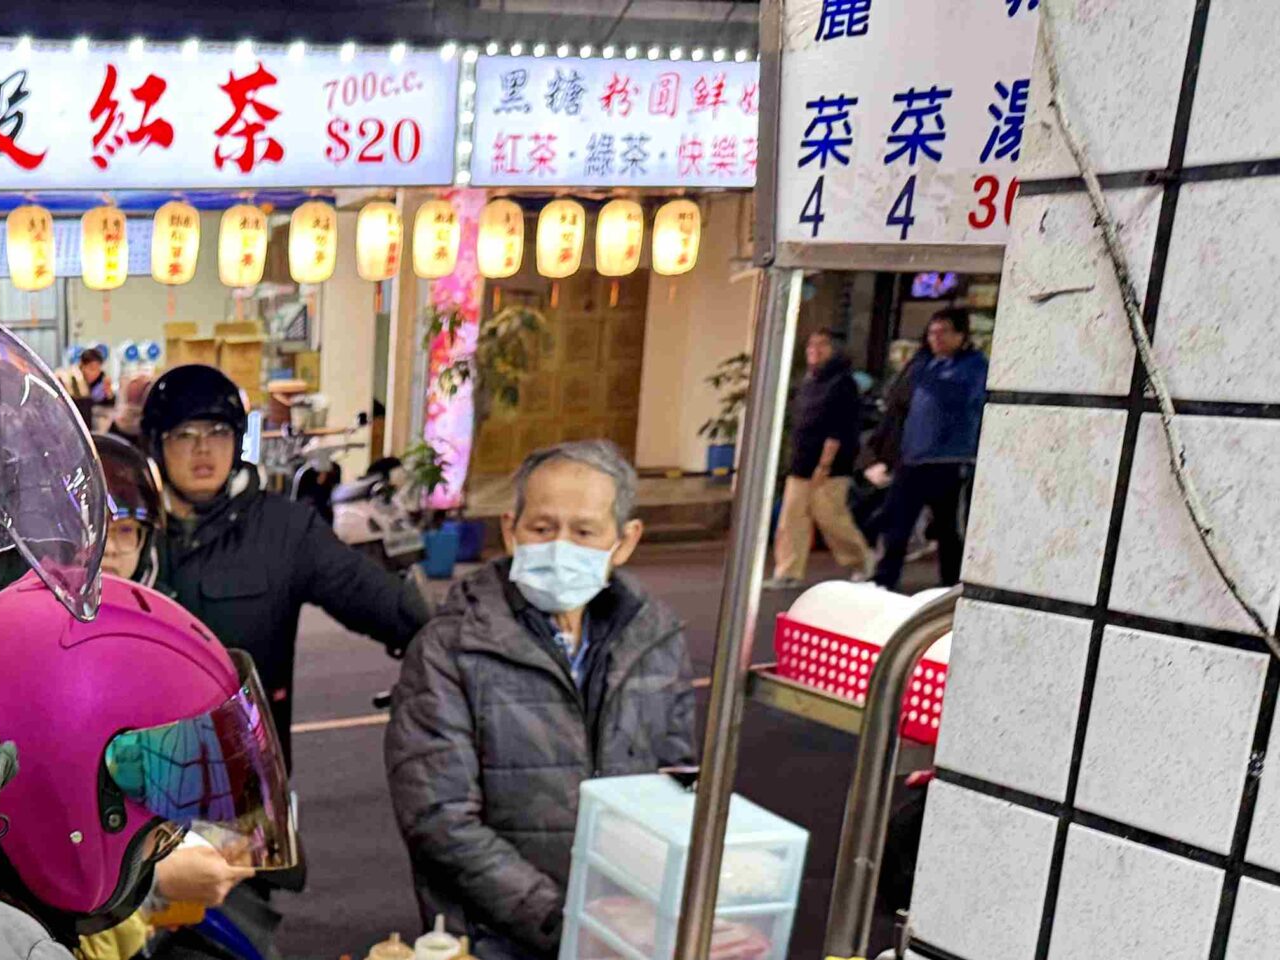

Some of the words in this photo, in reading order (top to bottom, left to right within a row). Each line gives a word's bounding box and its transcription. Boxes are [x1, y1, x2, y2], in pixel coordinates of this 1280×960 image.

[324, 66, 424, 111] 700c.c.
[324, 115, 422, 165] $20
[883, 85, 953, 166] 菜
[799, 174, 825, 238] 4
[886, 174, 917, 240] 4
